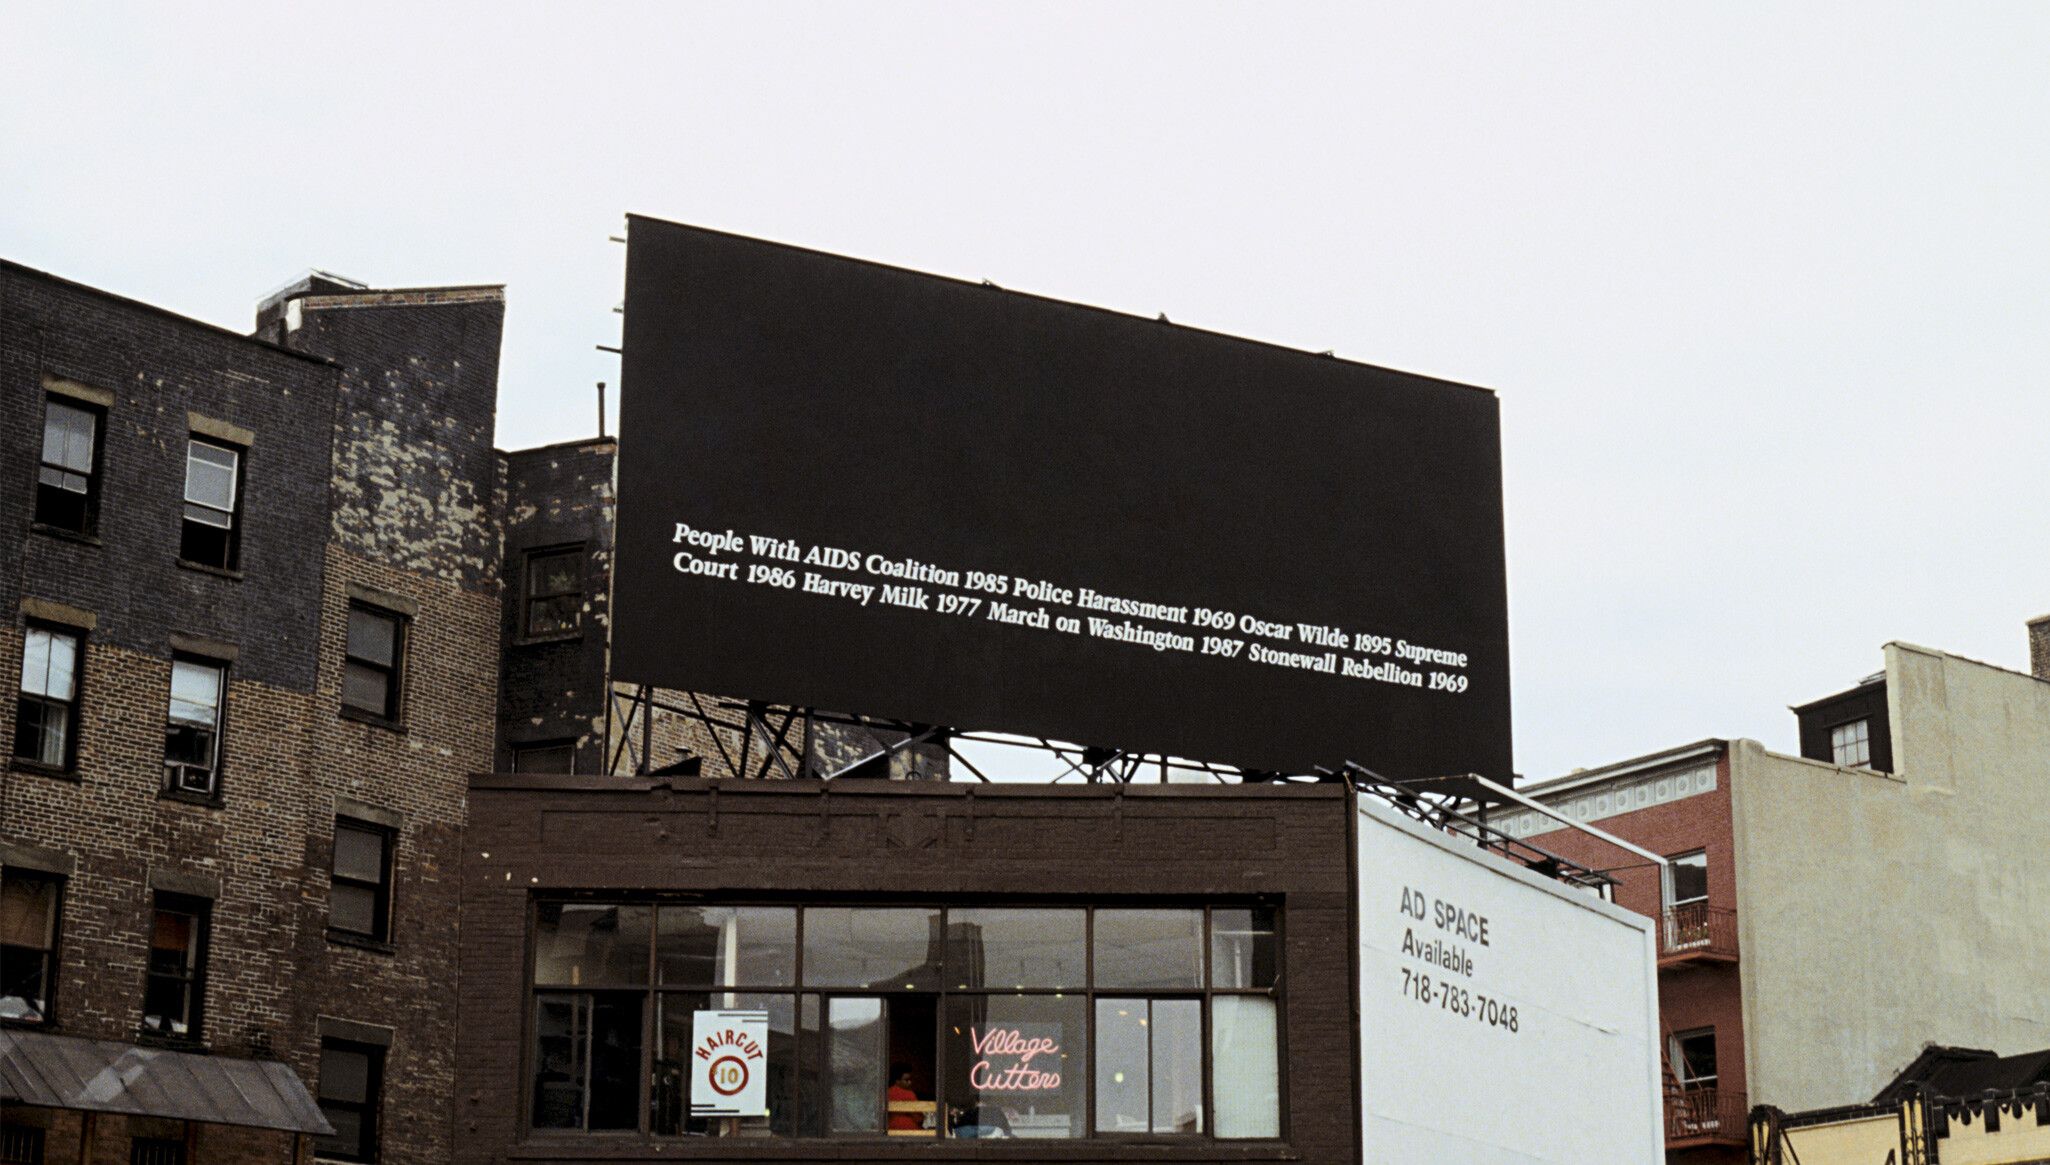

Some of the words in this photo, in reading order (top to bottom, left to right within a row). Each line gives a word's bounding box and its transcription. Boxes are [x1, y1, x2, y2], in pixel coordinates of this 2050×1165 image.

[673, 523, 743, 555] People
[748, 534, 801, 563] With
[803, 546, 861, 570] AIDS
[865, 554, 960, 588] Coalition
[963, 570, 1008, 595] 1985
[1012, 577, 1073, 606] Police
[1076, 587, 1188, 624] Harassment
[1192, 607, 1236, 631] 1969
[1239, 614, 1294, 641] Oscar
[1297, 623, 1349, 649] Wilde
[1354, 633, 1392, 656] 1895
[1394, 639, 1468, 668] Supreme
[673, 551, 740, 581] Court
[746, 564, 797, 589] 1986
[802, 571, 876, 606] Harvey
[878, 583, 930, 611] Milk
[935, 593, 983, 617] 1977
[986, 600, 1050, 630] March
[1055, 616, 1081, 635] on
[1087, 616, 1195, 652] Washington
[1200, 635, 1245, 658] 1987
[1248, 642, 1337, 674] Stonewall
[1340, 656, 1423, 688] Rebellion
[1427, 671, 1469, 694] 1969
[1400, 886, 1426, 921] AD
[1434, 899, 1490, 947] SPACE
[1401, 928, 1474, 978] Available
[1401, 967, 1519, 1033] 718-783-7048
[695, 1029, 764, 1061] HAIRCUT
[970, 1027, 1059, 1063] Village
[970, 1061, 1061, 1090] Cutters
